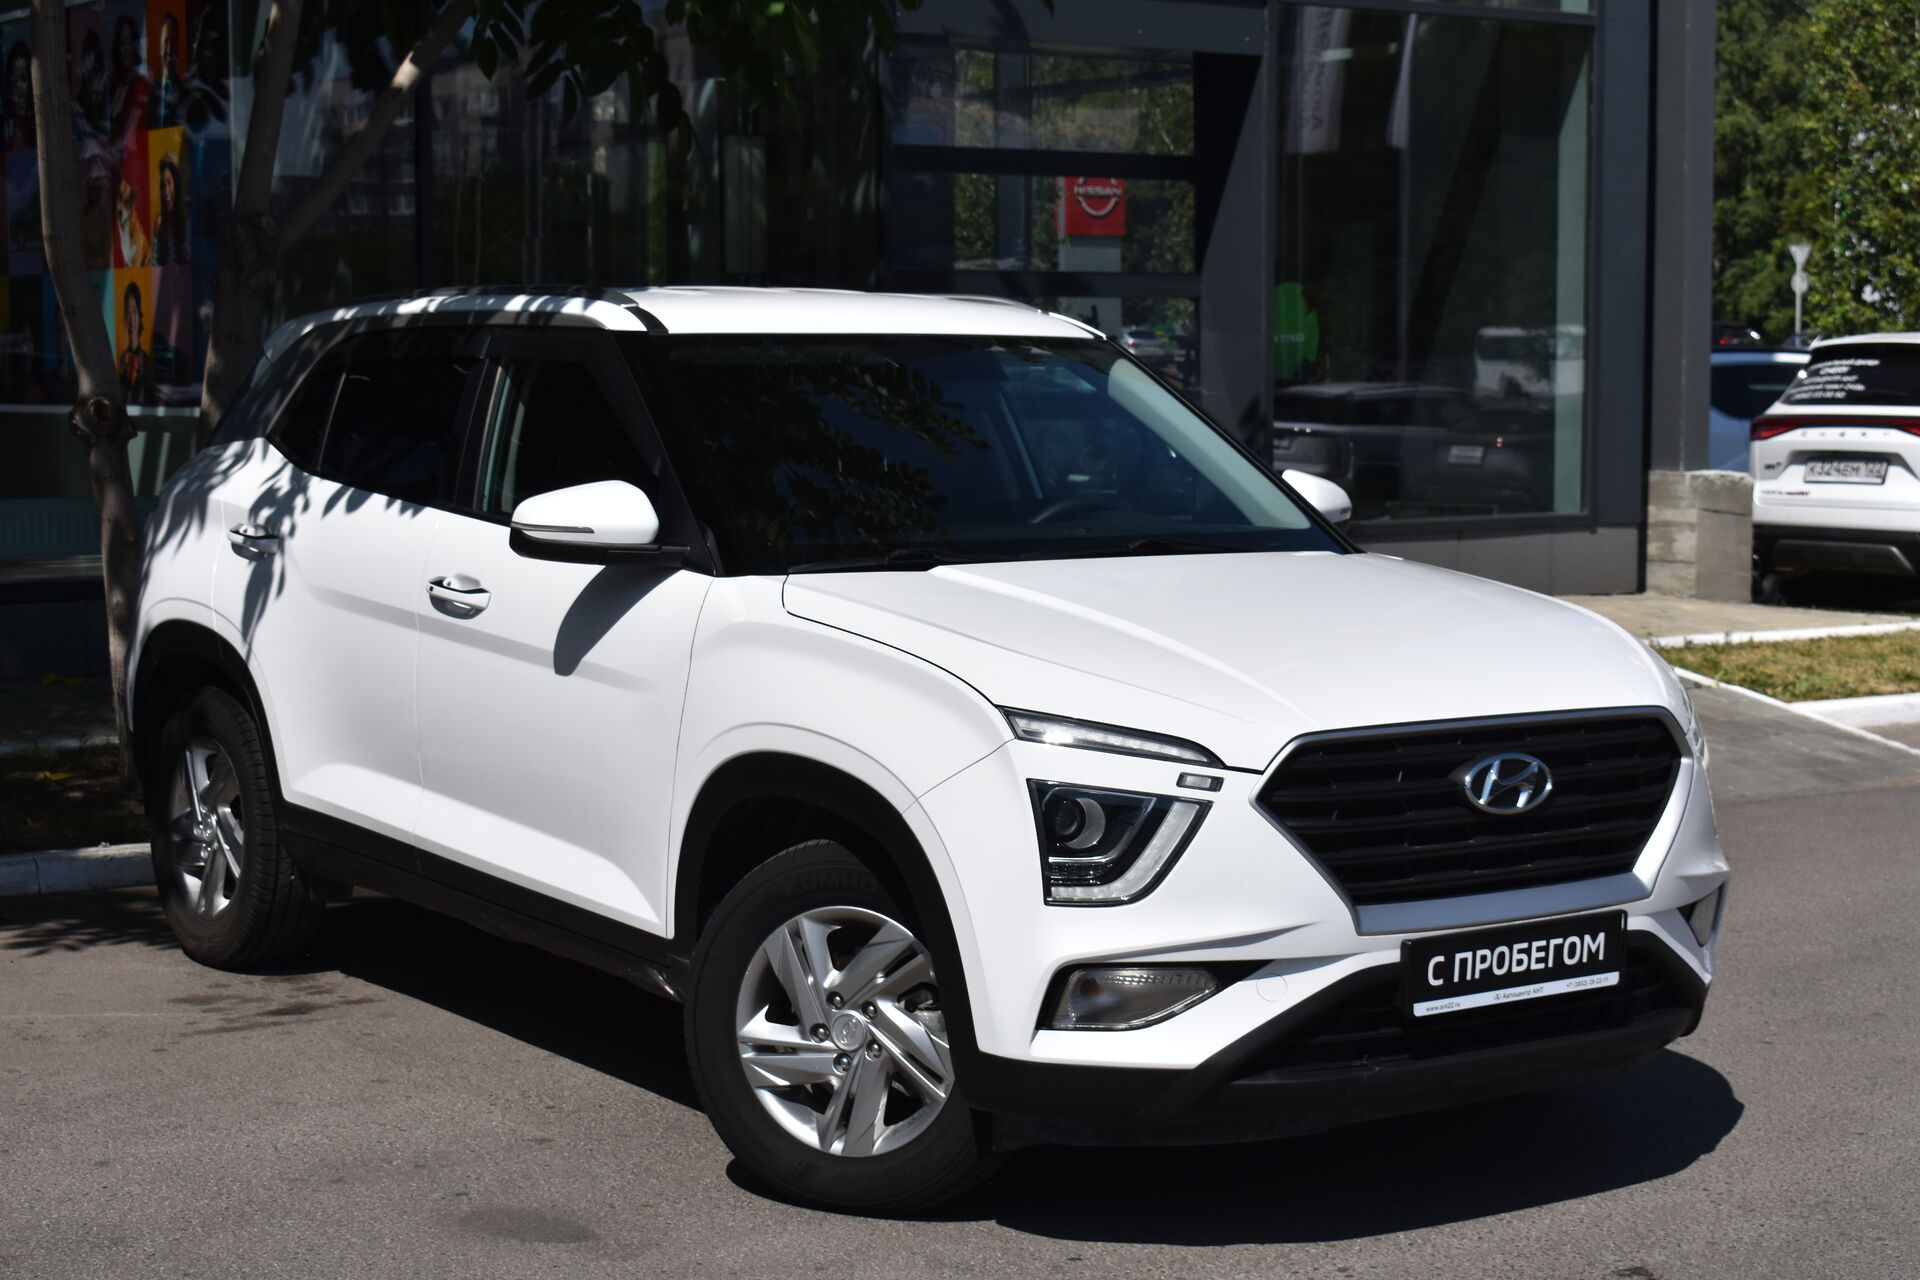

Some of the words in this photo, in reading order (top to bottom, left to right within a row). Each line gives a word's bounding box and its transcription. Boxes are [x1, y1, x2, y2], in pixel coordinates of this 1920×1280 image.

[1074, 185, 1121, 196] NISSAN
[1428, 955, 1445, 986] С
[1453, 932, 1606, 983] ПРОБЕГОМ
